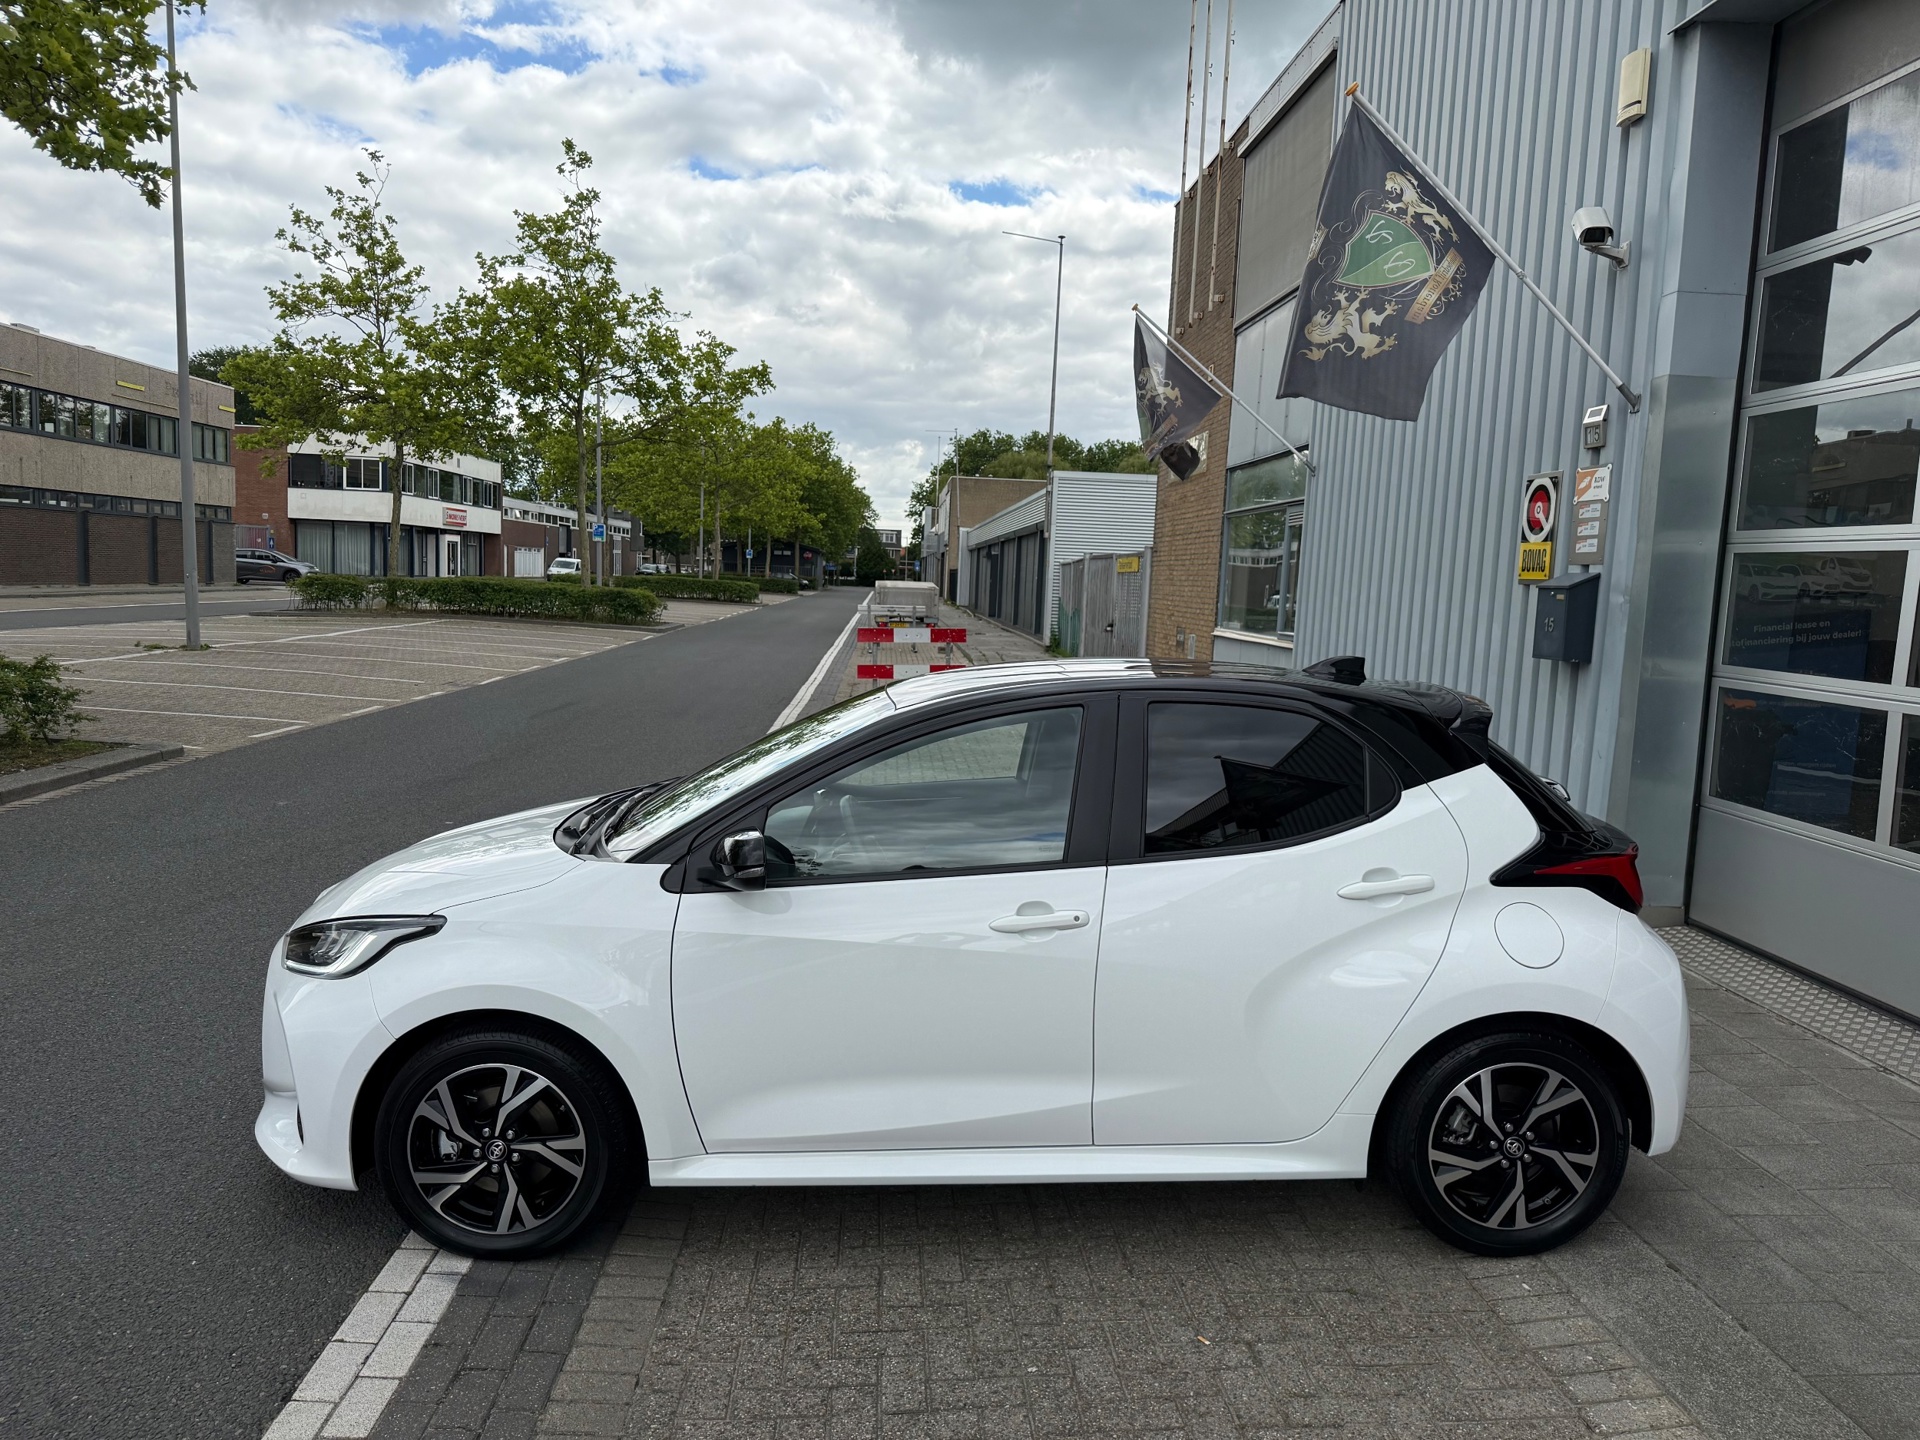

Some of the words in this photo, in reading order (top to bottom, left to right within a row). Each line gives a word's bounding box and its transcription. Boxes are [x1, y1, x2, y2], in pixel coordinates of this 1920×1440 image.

[1588, 426, 1600, 443] 15
[1521, 548, 1547, 573] BOVAG
[1544, 617, 1555, 632] 15
[1753, 622, 1793, 633] Financial
[1795, 620, 1818, 630] lease
[1819, 620, 1831, 628] en
[1795, 634, 1807, 643] bij
[1807, 632, 1831, 643] jouw
[1832, 629, 1862, 639] dealer!
